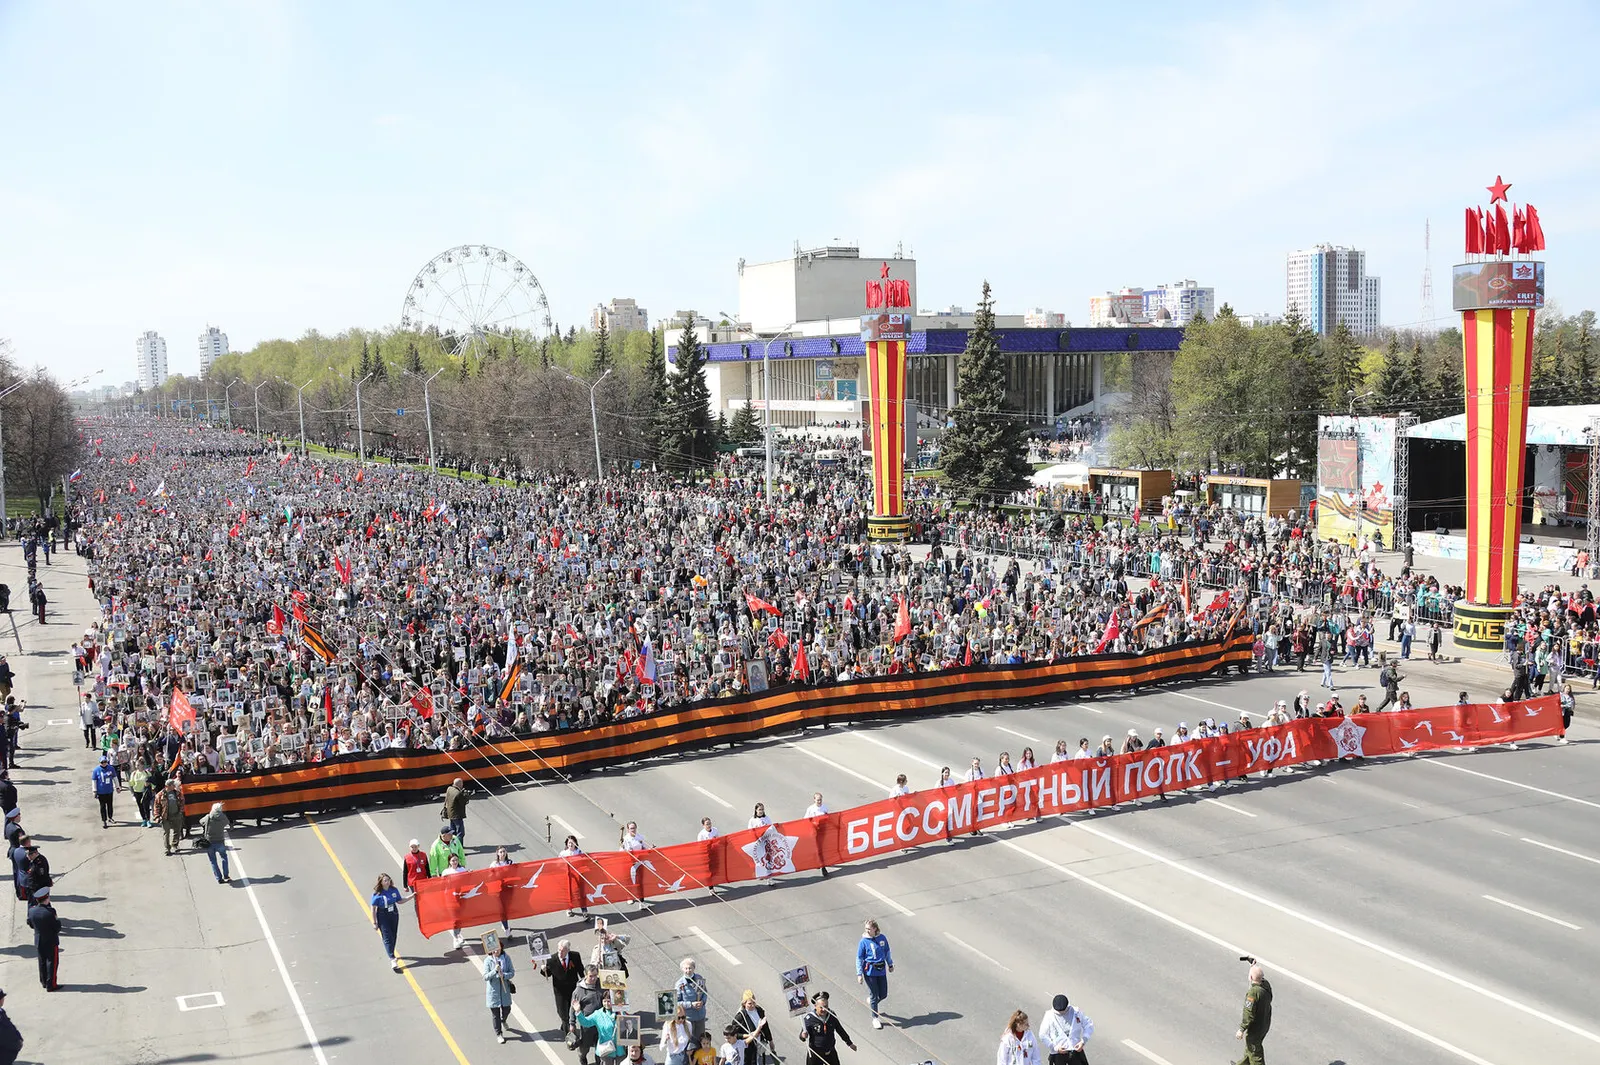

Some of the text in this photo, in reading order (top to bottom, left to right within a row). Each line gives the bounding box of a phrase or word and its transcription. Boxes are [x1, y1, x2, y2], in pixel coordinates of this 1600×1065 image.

[846, 760, 1111, 854] БЕССМЕРТНЫЙ
[1123, 748, 1202, 796] ПОЛК
[1247, 731, 1297, 769] УФА
